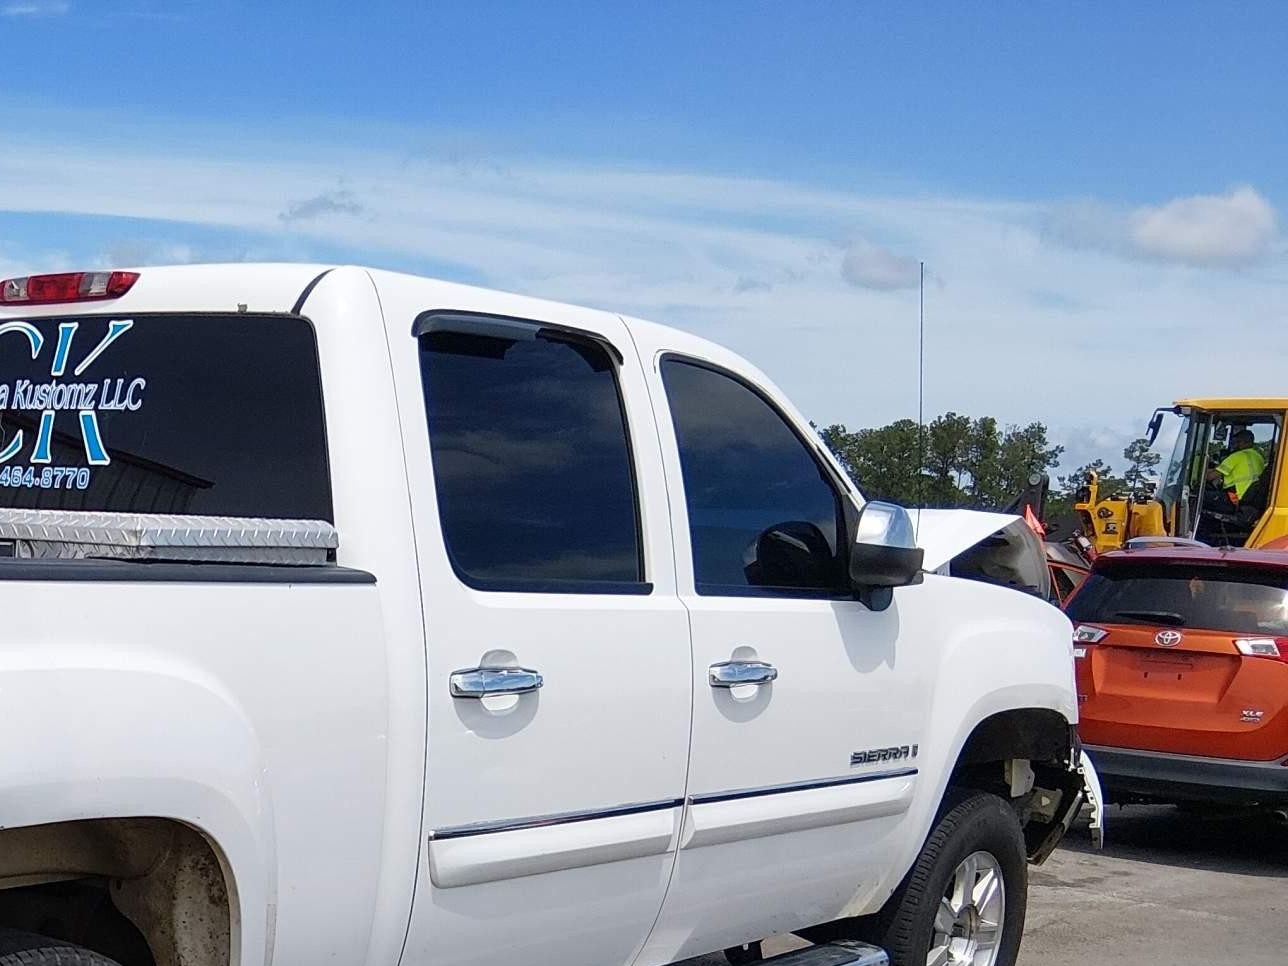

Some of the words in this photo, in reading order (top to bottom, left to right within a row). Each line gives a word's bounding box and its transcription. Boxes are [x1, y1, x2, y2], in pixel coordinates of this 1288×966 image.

[11, 379, 98, 410] Kustomz
[98, 378, 146, 411] LLC
[850, 746, 910, 766] SIERRA
